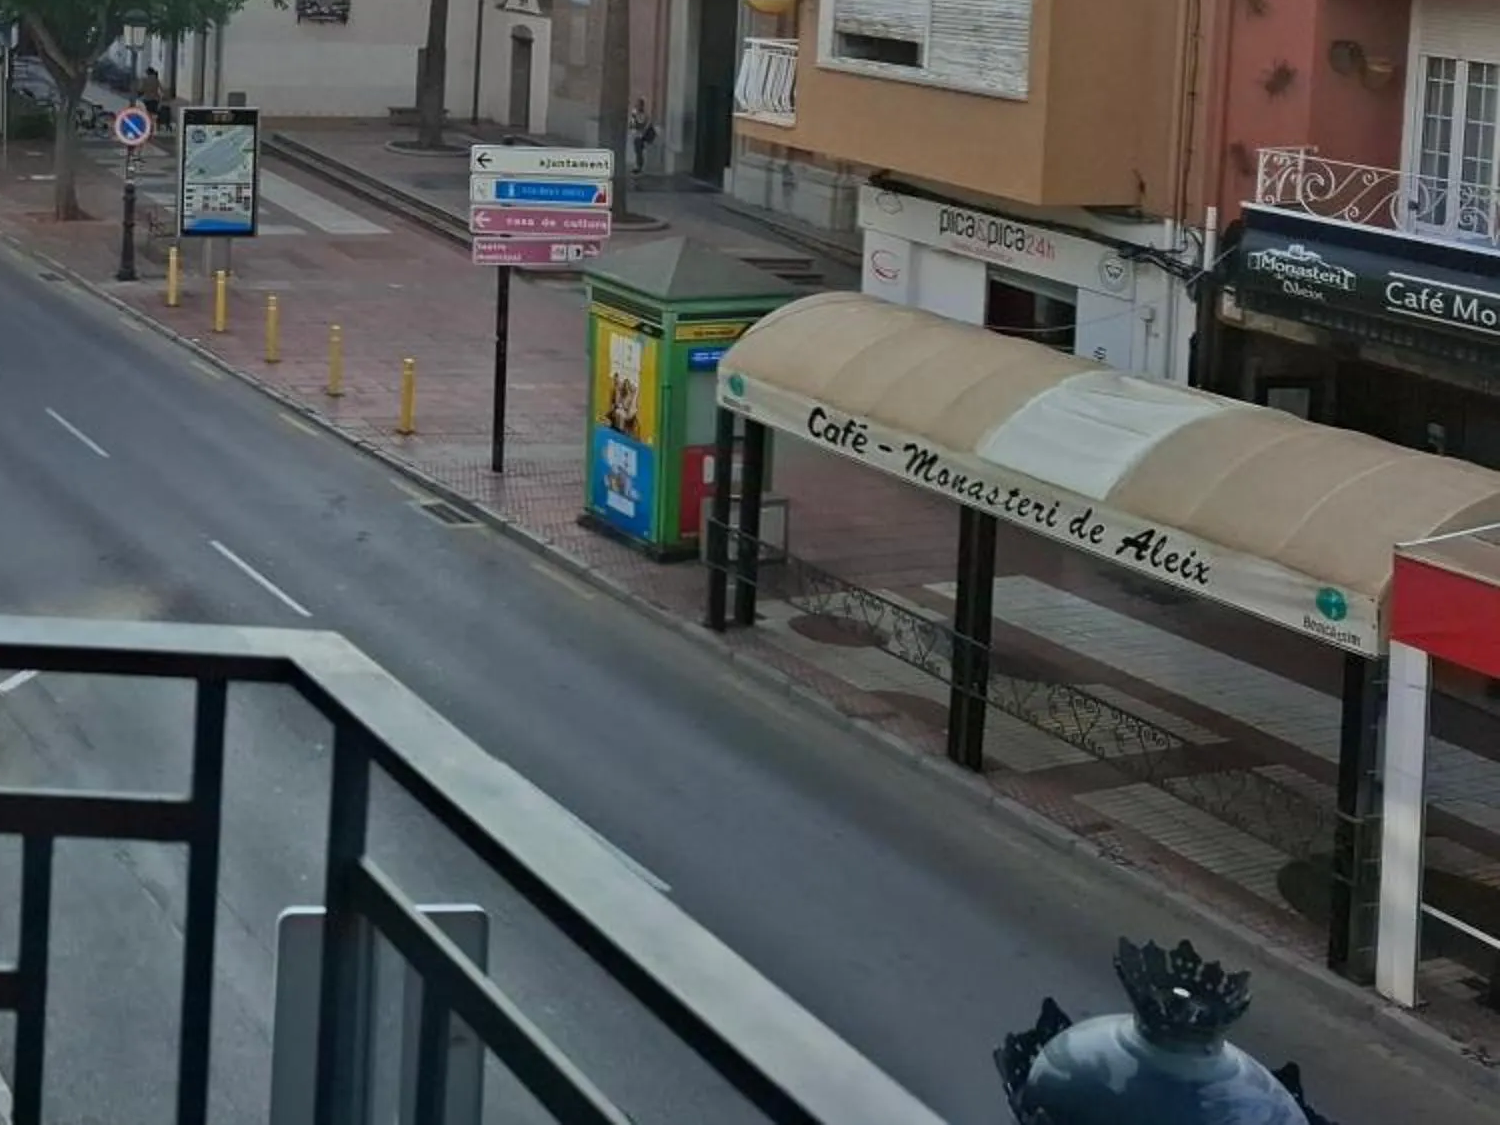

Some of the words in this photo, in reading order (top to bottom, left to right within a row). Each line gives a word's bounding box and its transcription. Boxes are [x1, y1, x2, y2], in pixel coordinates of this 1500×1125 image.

[541, 216, 557, 227] de
[1385, 281, 1445, 315] Café
[807, 406, 870, 454] Café
[903, 442, 1061, 528] Monasteri
[1069, 507, 1106, 544] de
[1115, 528, 1211, 585] Aleix
